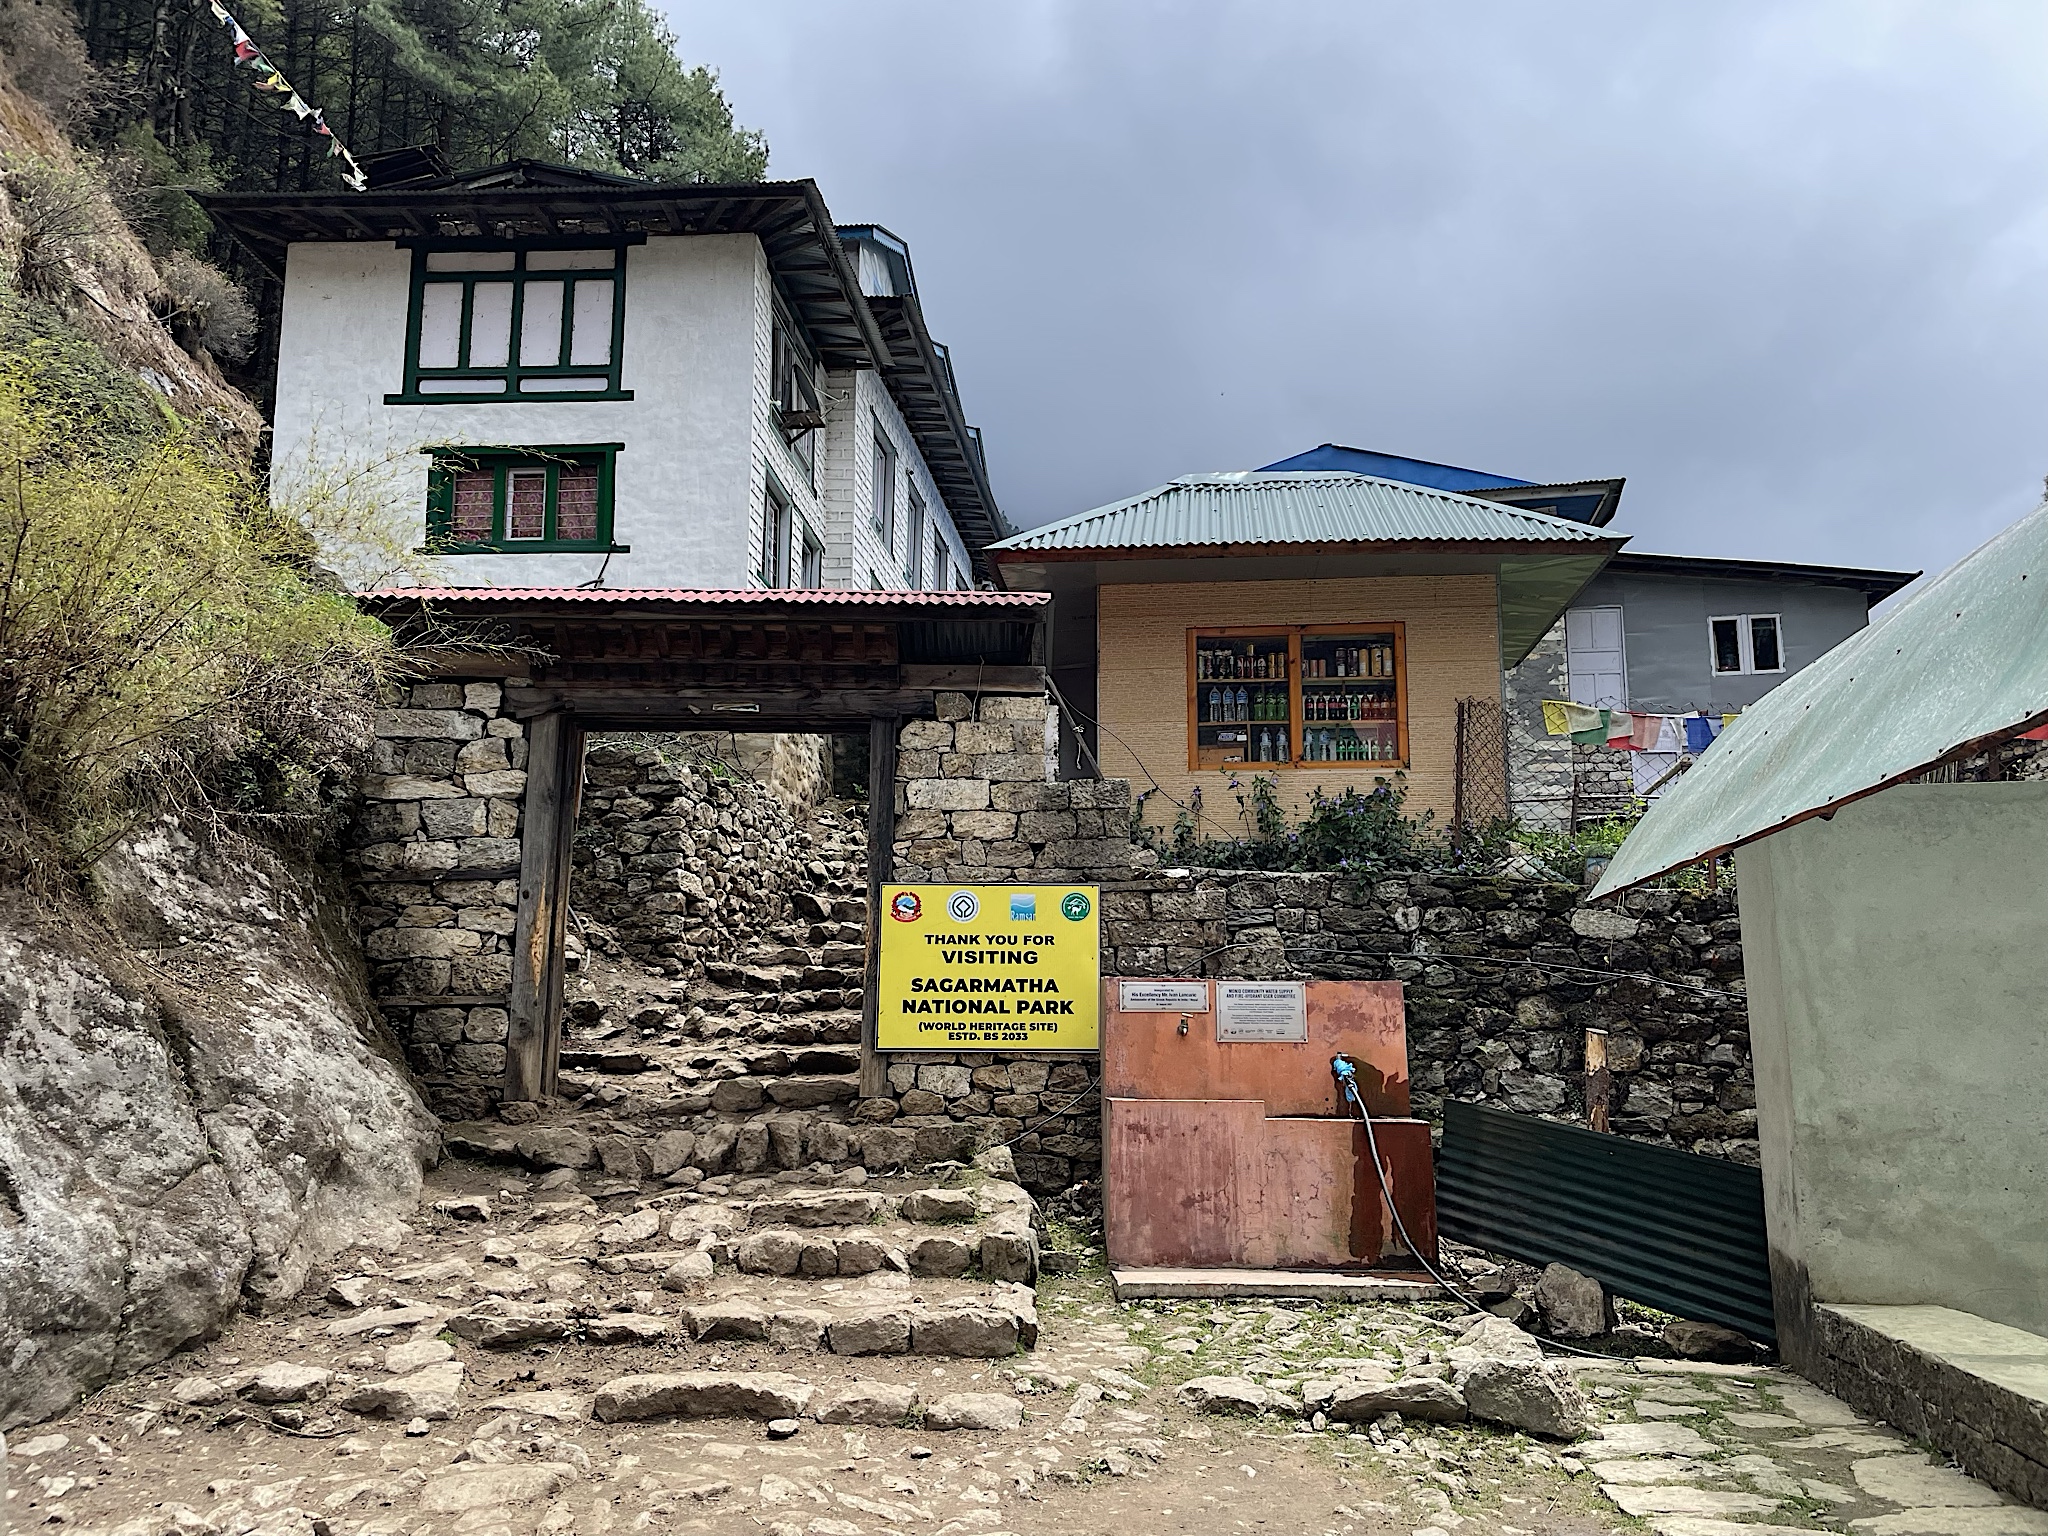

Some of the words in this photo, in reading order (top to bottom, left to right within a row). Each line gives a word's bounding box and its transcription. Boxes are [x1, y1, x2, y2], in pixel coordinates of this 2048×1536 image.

[1011, 910, 1036, 921] Ramsar
[924, 934, 980, 945] THANK
[985, 935, 1018, 945] YOU
[1023, 935, 1055, 946] FOR
[941, 950, 1038, 965] VISITING
[910, 977, 1059, 993] SAGARMATHA
[902, 999, 1011, 1014] NATIONAL
[1016, 1000, 1074, 1015] PARK
[918, 1022, 967, 1033] (WORLD
[969, 1022, 1026, 1031] HERITAGE
[1029, 1022, 1058, 1033] SITE)
[947, 1032, 981, 1041] ESTD.
[983, 1032, 998, 1041] BS
[1001, 1032, 1028, 1041] 2033
